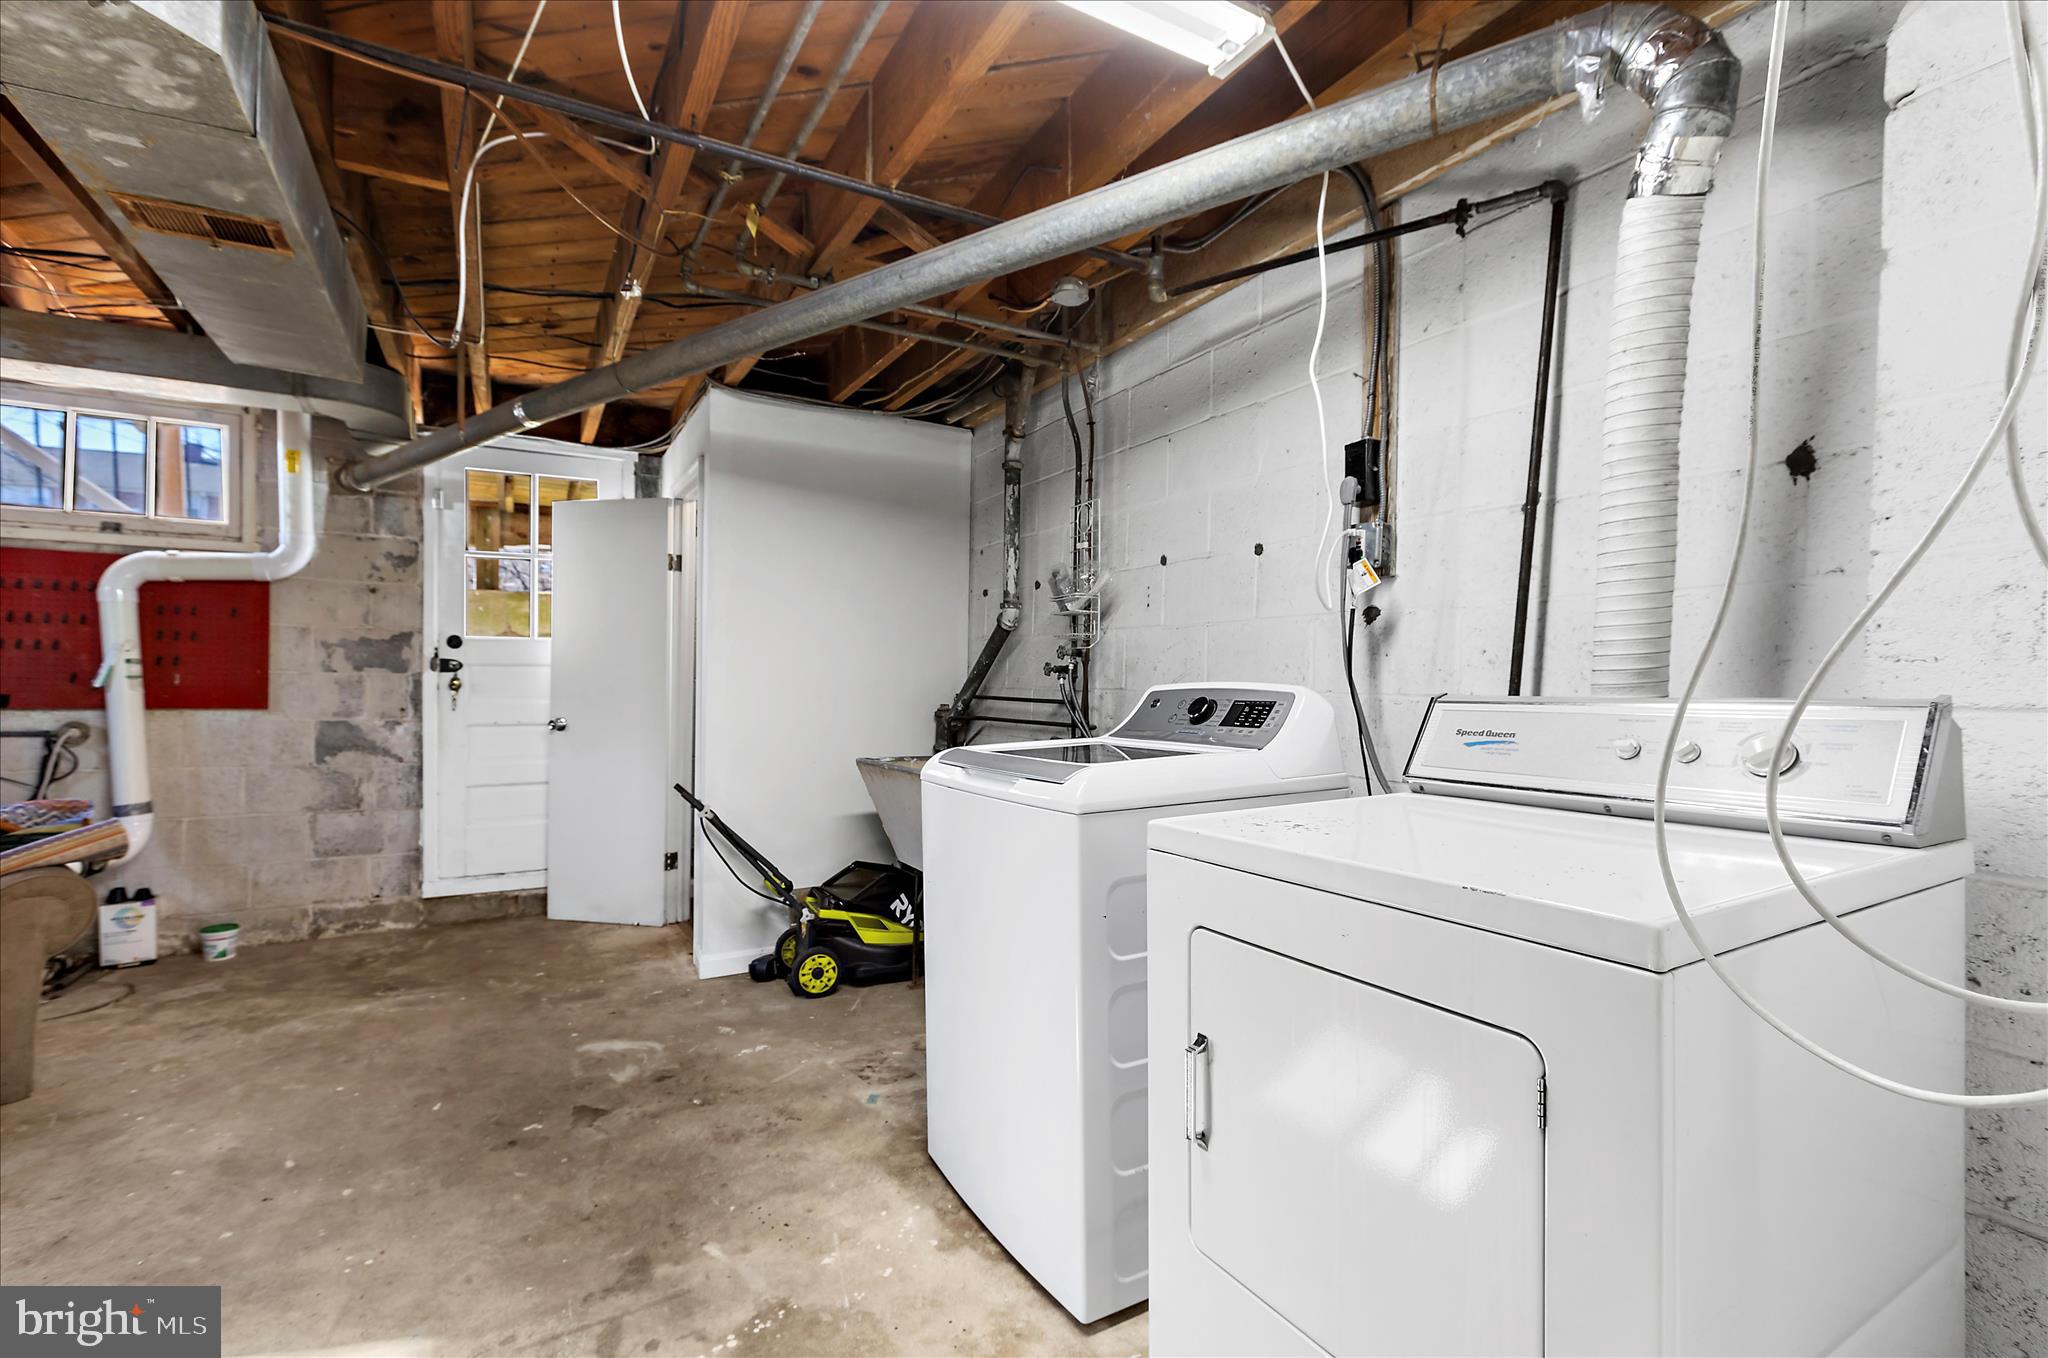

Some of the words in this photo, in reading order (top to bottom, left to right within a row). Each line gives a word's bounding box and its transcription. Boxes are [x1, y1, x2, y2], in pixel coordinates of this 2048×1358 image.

[1456, 728, 1485, 737] Speed
[1486, 729, 1516, 738] Queen
[890, 893, 915, 927] RY
